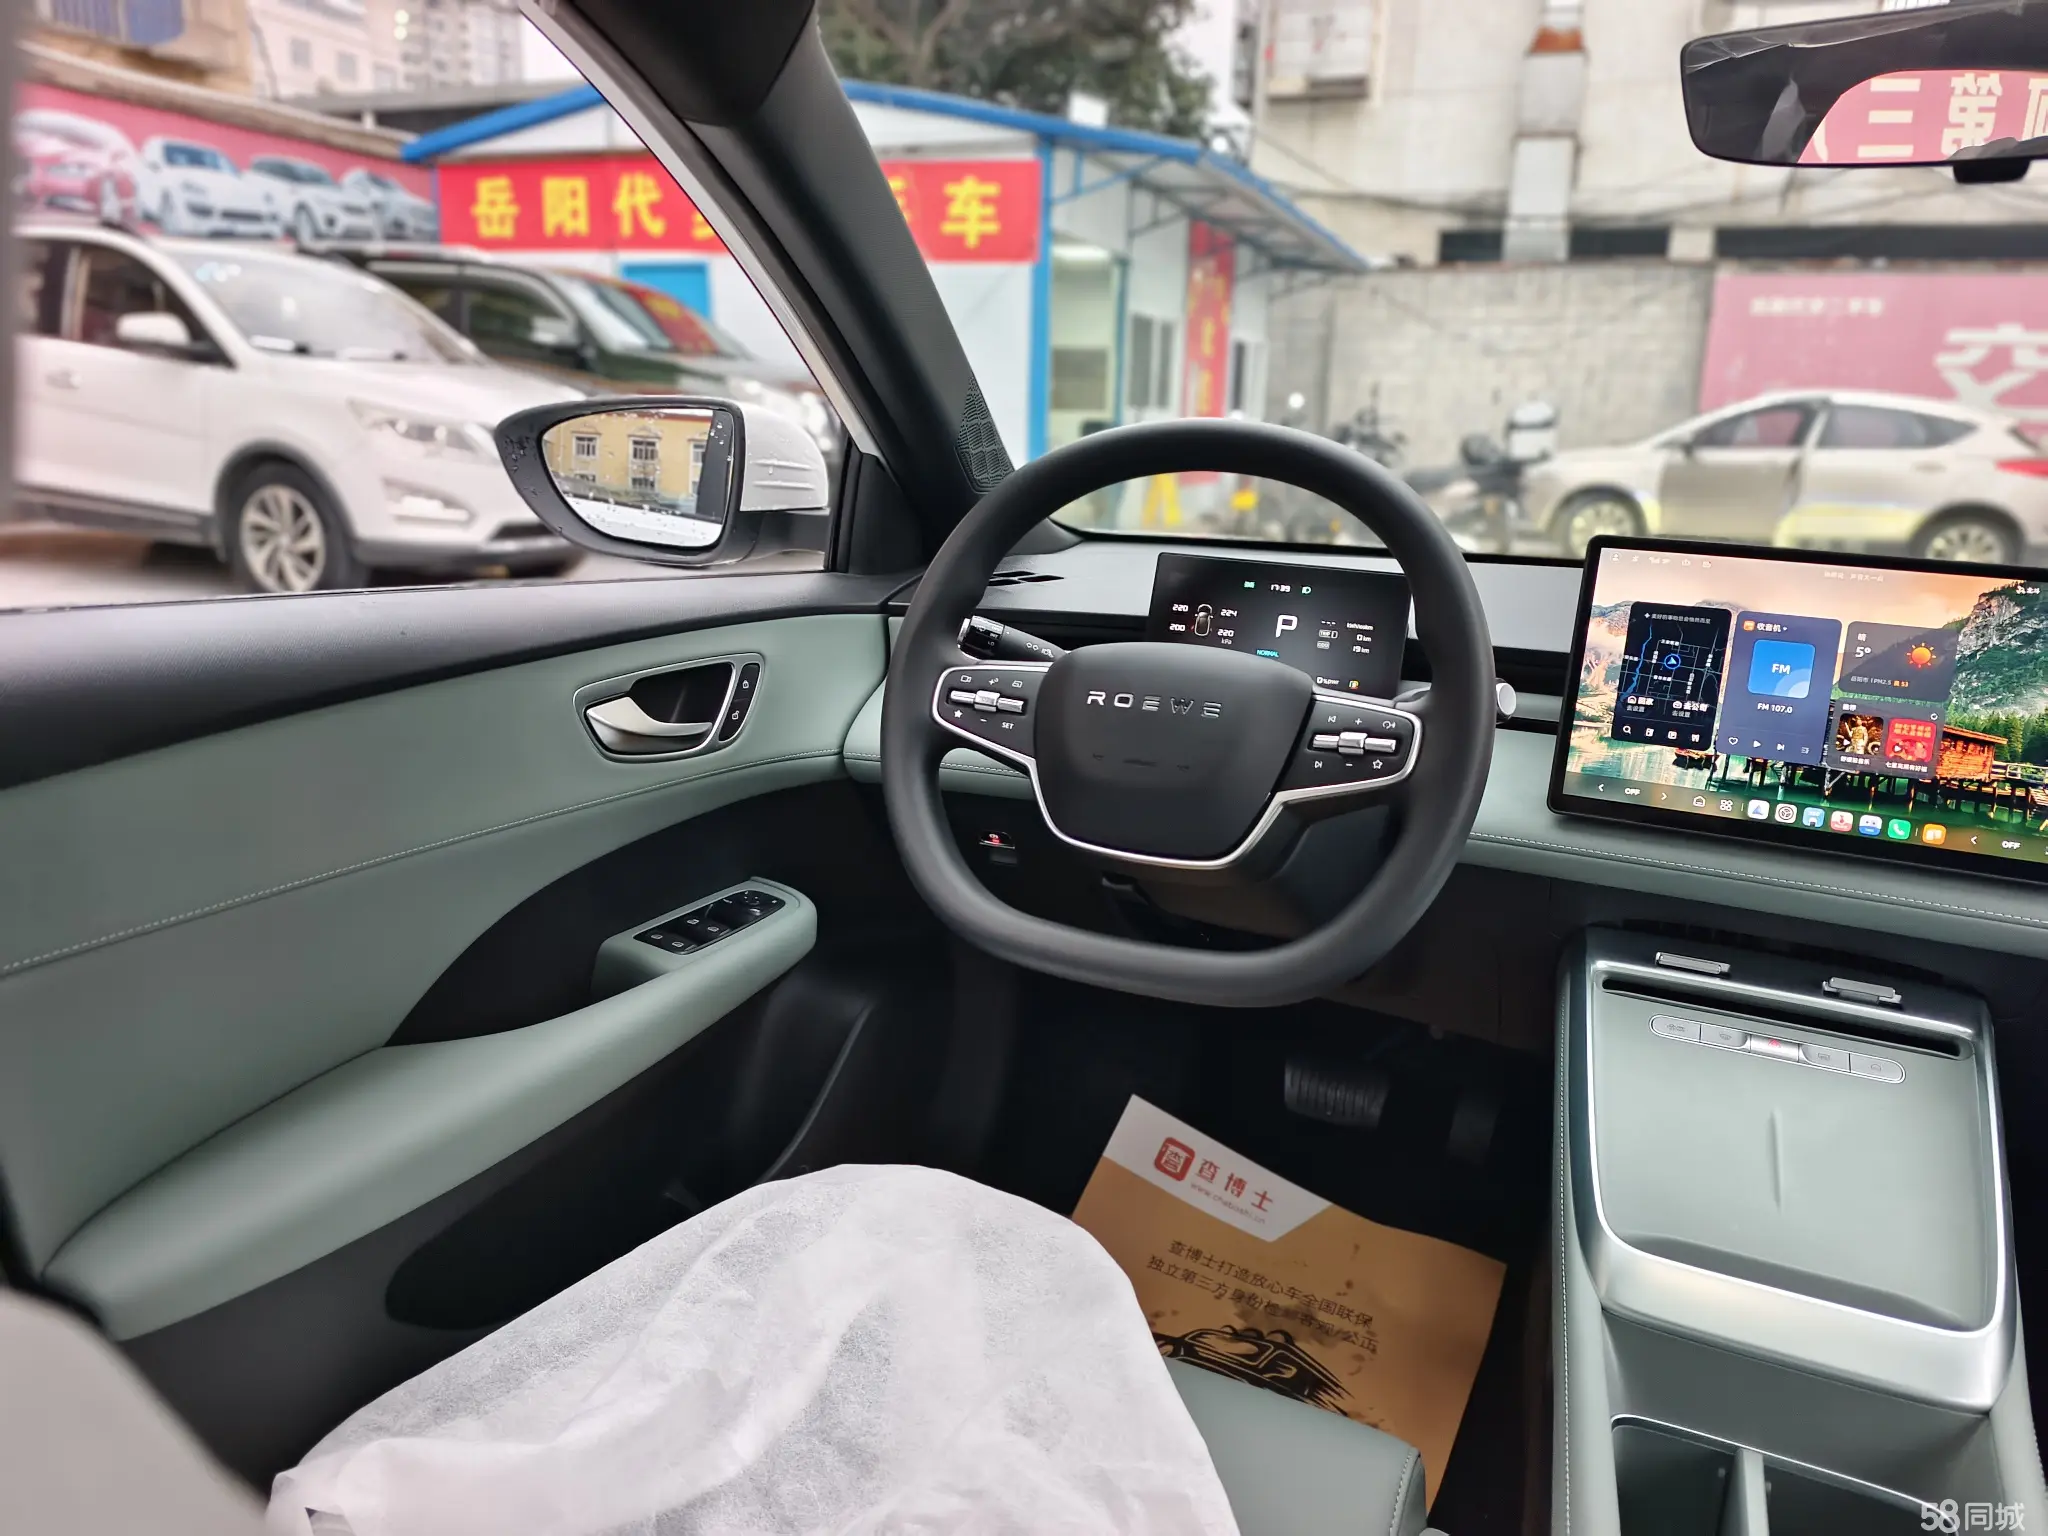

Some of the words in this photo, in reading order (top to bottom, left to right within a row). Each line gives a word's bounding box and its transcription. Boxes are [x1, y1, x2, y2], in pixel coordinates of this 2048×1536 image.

[471, 171, 715, 240] 岳阳代
[1172, 604, 1189, 612] 220
[1169, 623, 1186, 632] 200
[1275, 614, 1299, 639] P
[1757, 622, 1782, 632] 收音机
[1217, 629, 1235, 637] 220
[1256, 649, 1279, 658] NORMAL
[1771, 663, 1791, 675] FM
[1086, 690, 1223, 719] ROEWE
[1757, 702, 1770, 711] FM
[1771, 704, 1793, 714] 107.0
[1001, 721, 1015, 730] SET
[1624, 786, 1641, 796] OFF
[2001, 840, 2021, 850] OFF
[1195, 1158, 1273, 1213] 查博士
[1168, 1239, 1374, 1328] 查博士打造放心车全国联保
